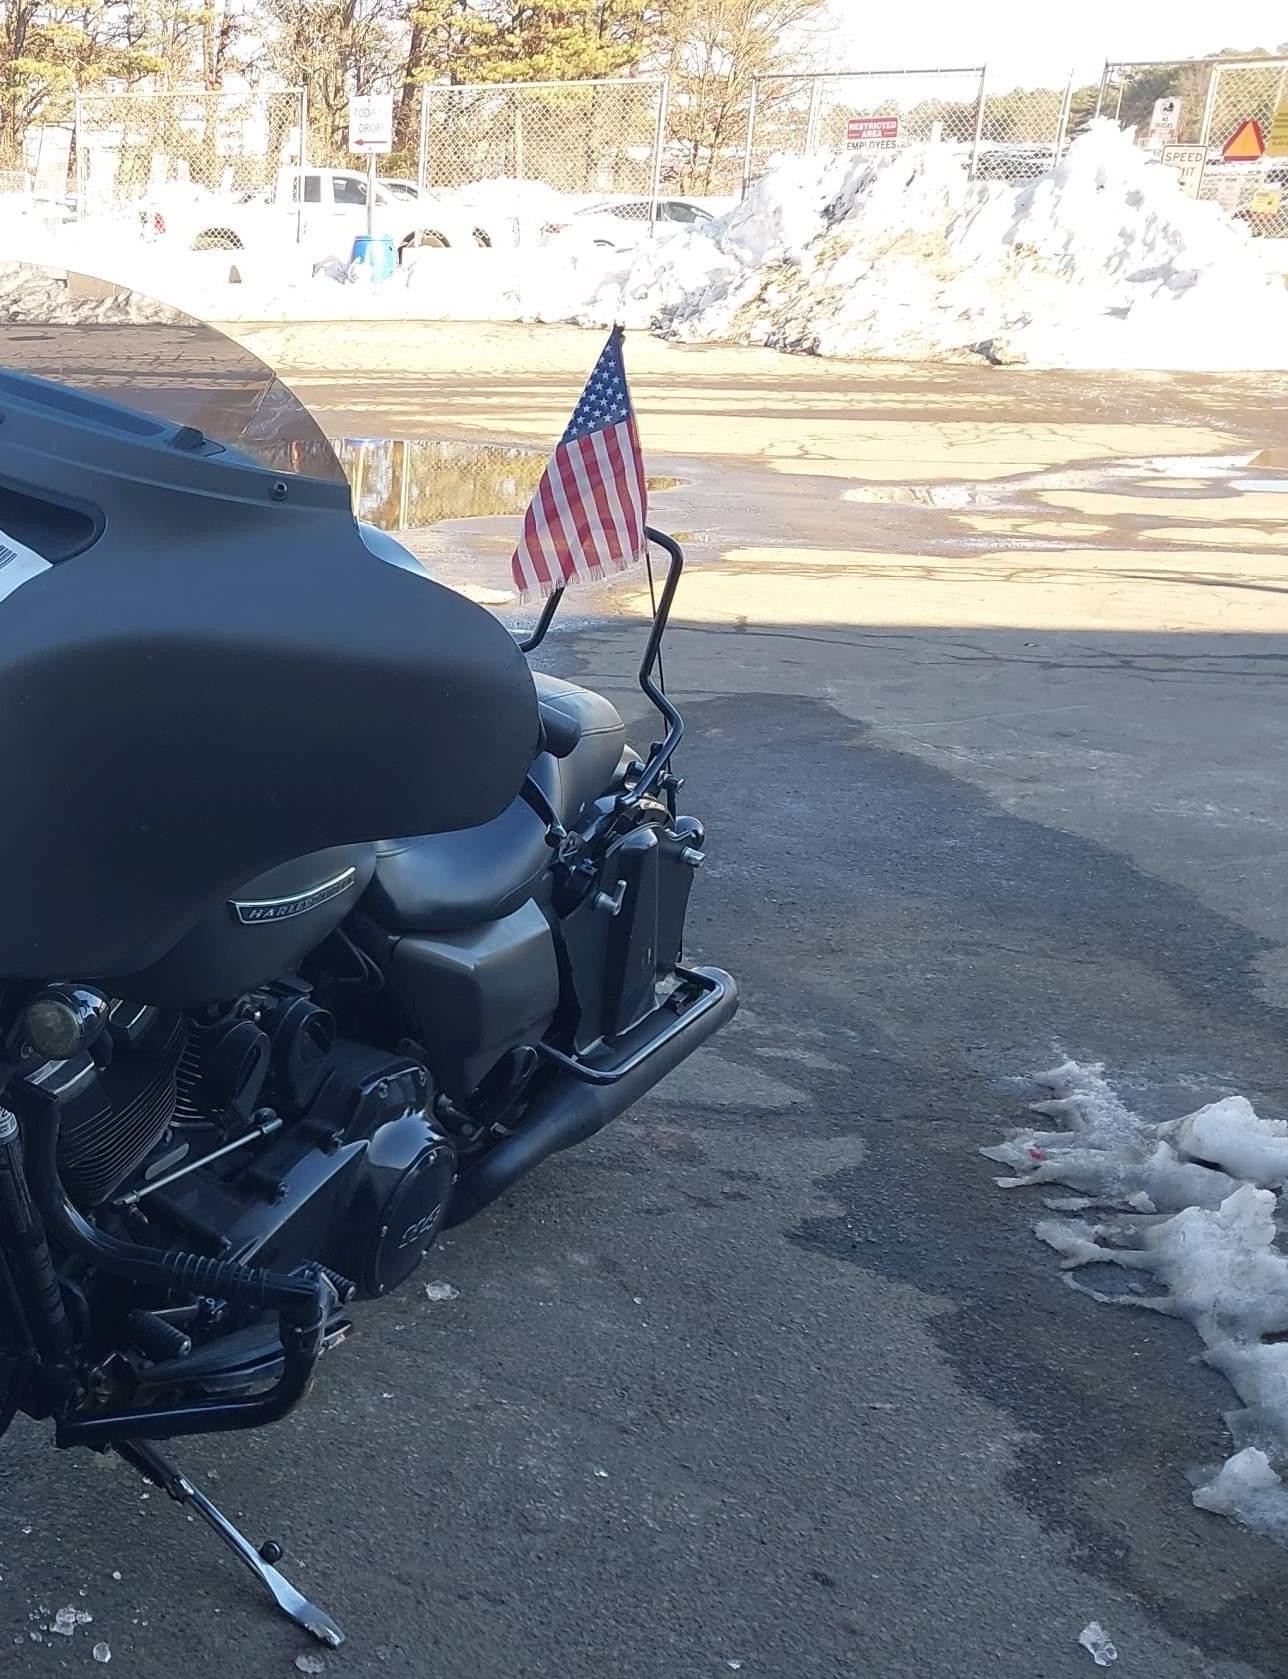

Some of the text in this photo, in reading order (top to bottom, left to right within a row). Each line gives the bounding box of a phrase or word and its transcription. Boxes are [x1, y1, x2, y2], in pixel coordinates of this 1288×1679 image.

[849, 121, 897, 130] RESTRICTED
[861, 130, 882, 138] AREA
[847, 140, 897, 150] EMPLOYEES
[1164, 152, 1203, 162] SPEED
